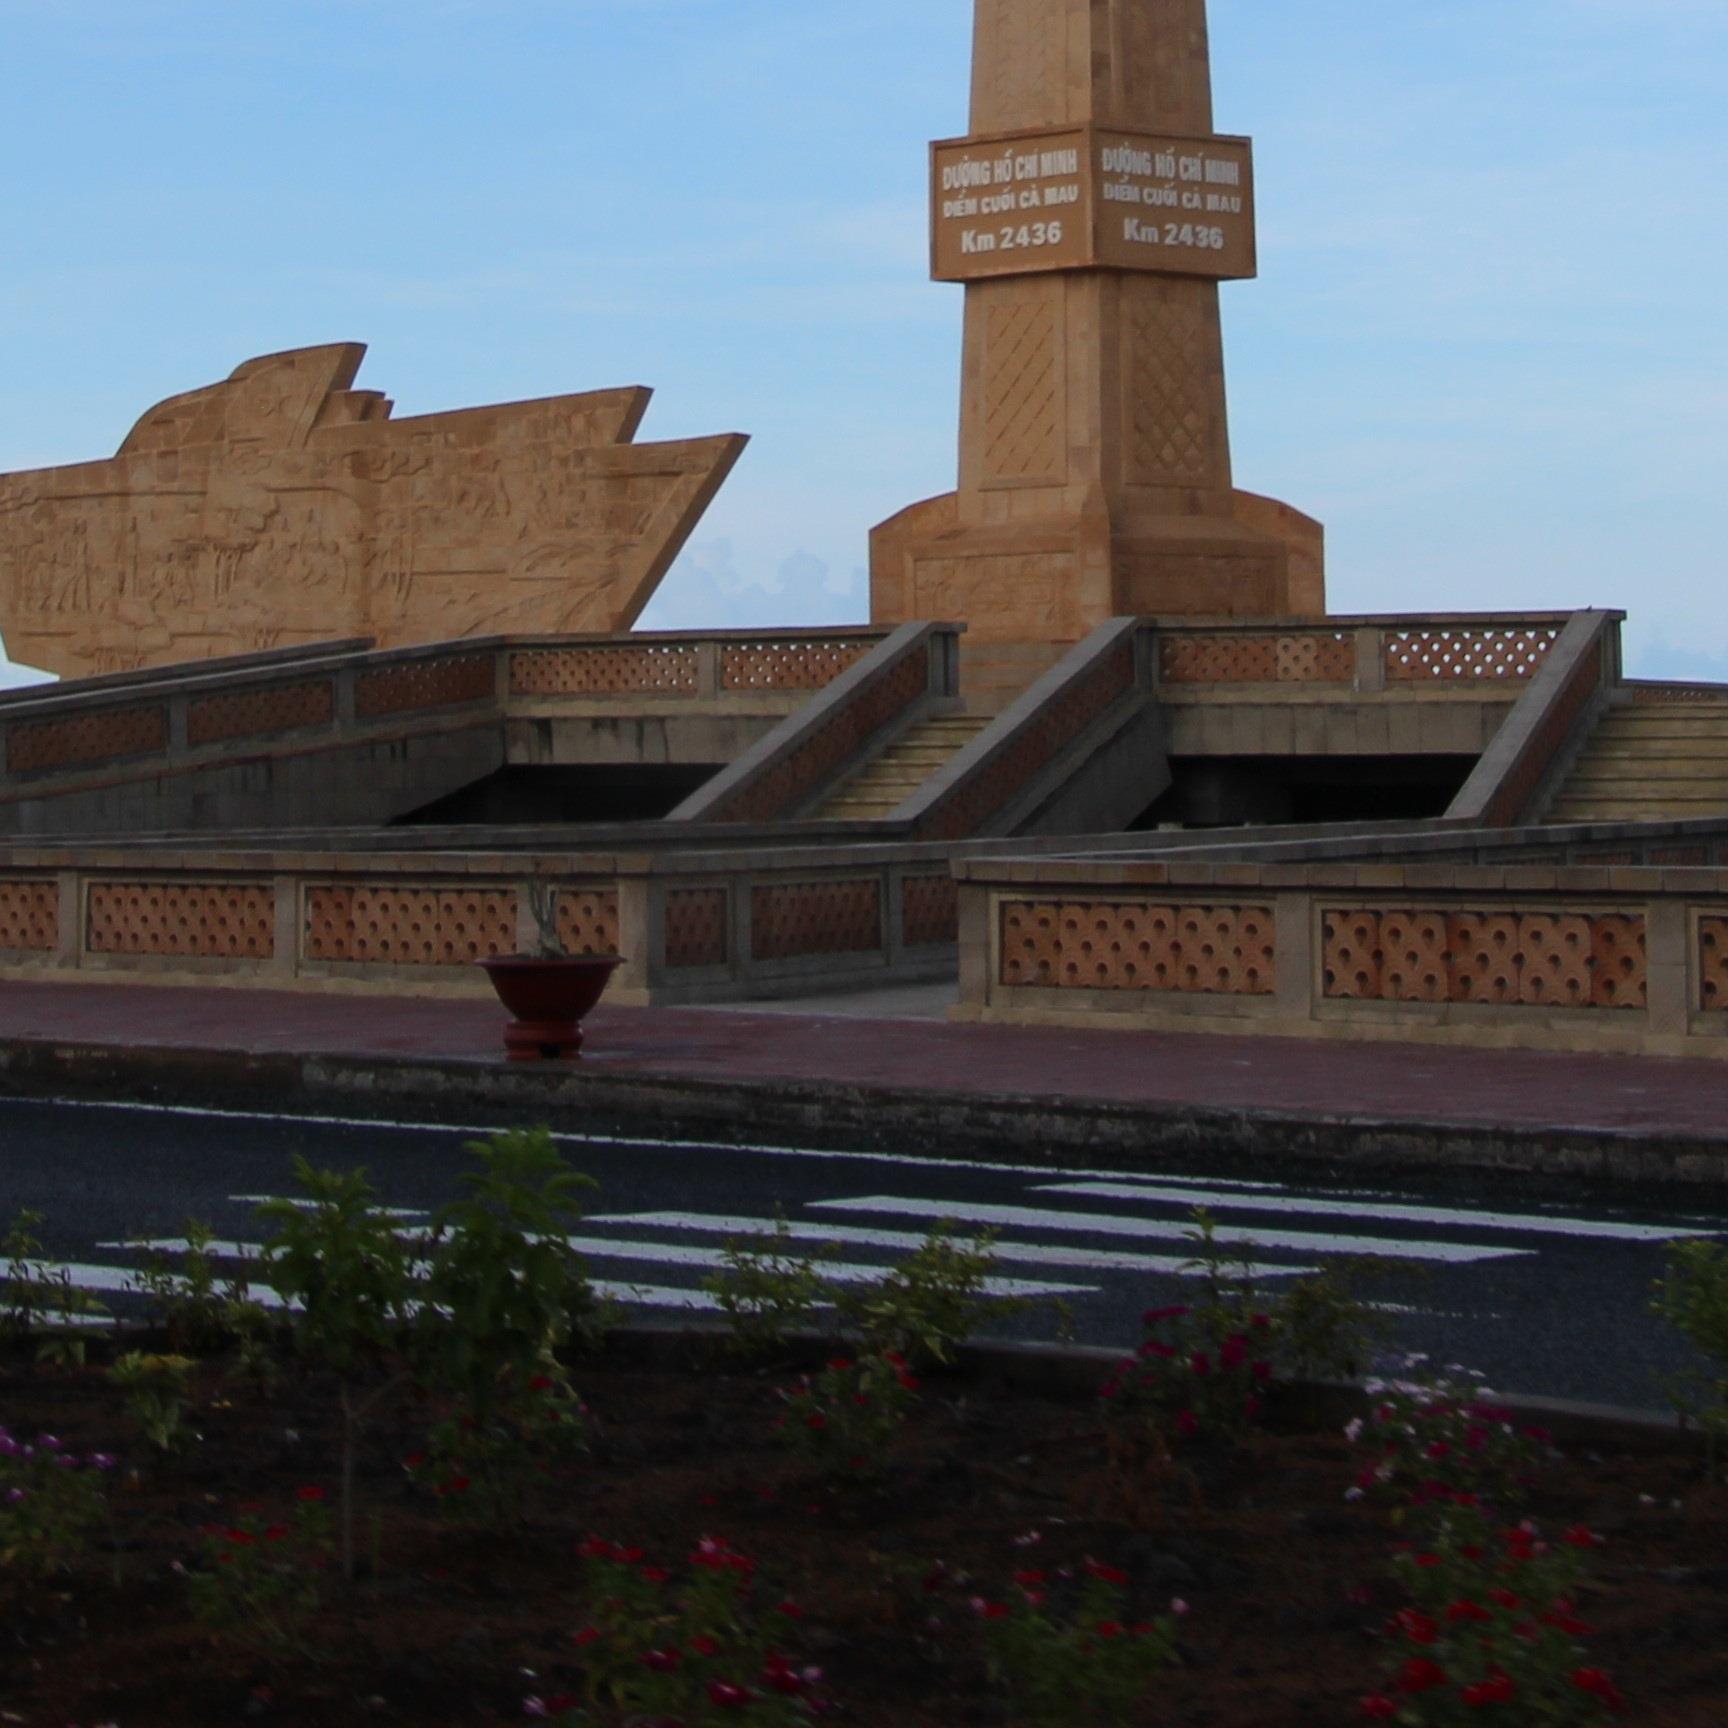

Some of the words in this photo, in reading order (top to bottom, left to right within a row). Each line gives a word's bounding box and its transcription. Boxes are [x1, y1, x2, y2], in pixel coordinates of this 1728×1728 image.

[1040, 149, 1078, 177] MINH
[1205, 159, 1239, 186] MINH
[1044, 185, 1078, 206] MAU
[1206, 194, 1241, 213] MAU
[961, 229, 995, 253] Km
[1000, 221, 1062, 249] 2436
[1124, 218, 1158, 243] Km
[1164, 223, 1224, 250] 2436
